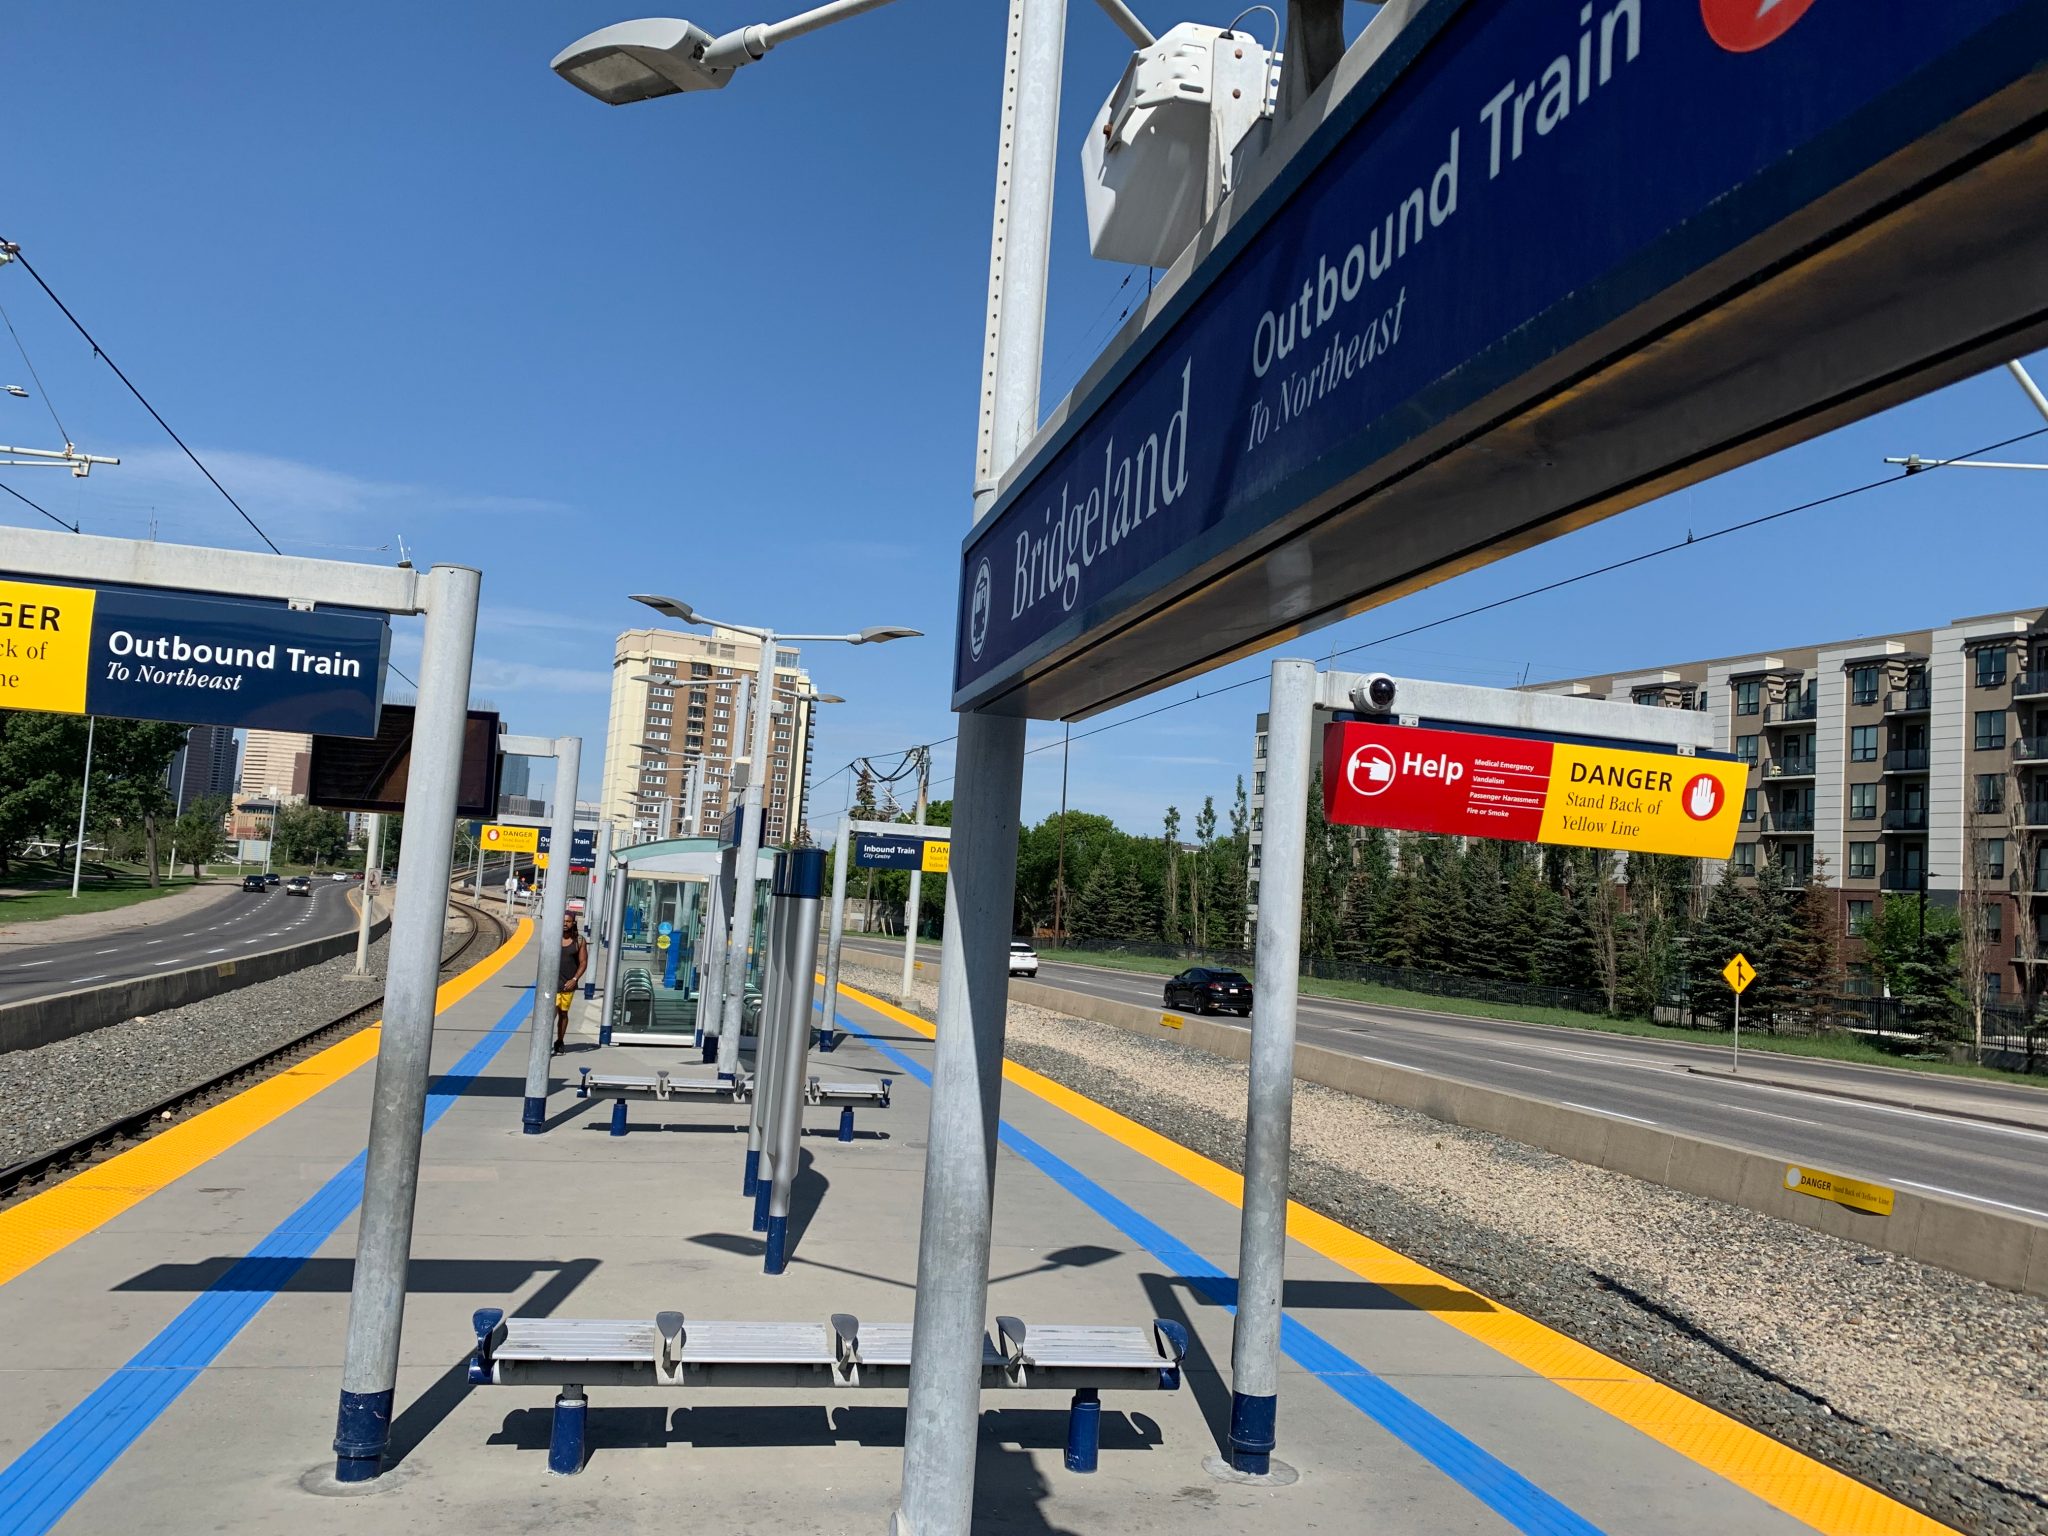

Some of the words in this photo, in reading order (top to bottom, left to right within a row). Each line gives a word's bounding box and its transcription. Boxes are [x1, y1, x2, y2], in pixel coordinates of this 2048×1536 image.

[1253, 126, 1460, 378] Outbound
[1480, 0, 1640, 180] Train
[1248, 398, 1269, 452] To
[1275, 286, 1407, 432] Northeast
[1010, 354, 1192, 621] Bridgeland
[0, 601, 61, 632] GER
[26, 641, 49, 661] of
[108, 630, 276, 670] Outbound
[286, 648, 361, 678] Train
[106, 661, 130, 681] To
[135, 664, 243, 691] Northeast
[1402, 751, 1464, 786] Help
[1474, 758, 1500, 768] Medical
[1500, 761, 1535, 773] Emergency
[1472, 775, 1505, 785] Vandalism
[1570, 762, 1673, 793] DANGER
[1469, 791, 1502, 802] Passenger
[1502, 794, 1540, 805] Harassment
[1565, 791, 1606, 809] Stand
[1608, 795, 1644, 814] Back
[1647, 799, 1664, 816] of
[1466, 807, 1479, 815] Fire
[1487, 808, 1510, 818] Smoke
[503, 830, 532, 838] DANGER
[1561, 815, 1608, 833] Yellow
[1610, 820, 1641, 837] Line
[864, 844, 895, 854] Inbound
[896, 846, 916, 854] Train
[930, 846, 949, 854] DAN
[1800, 1176, 1832, 1192] DANGER
